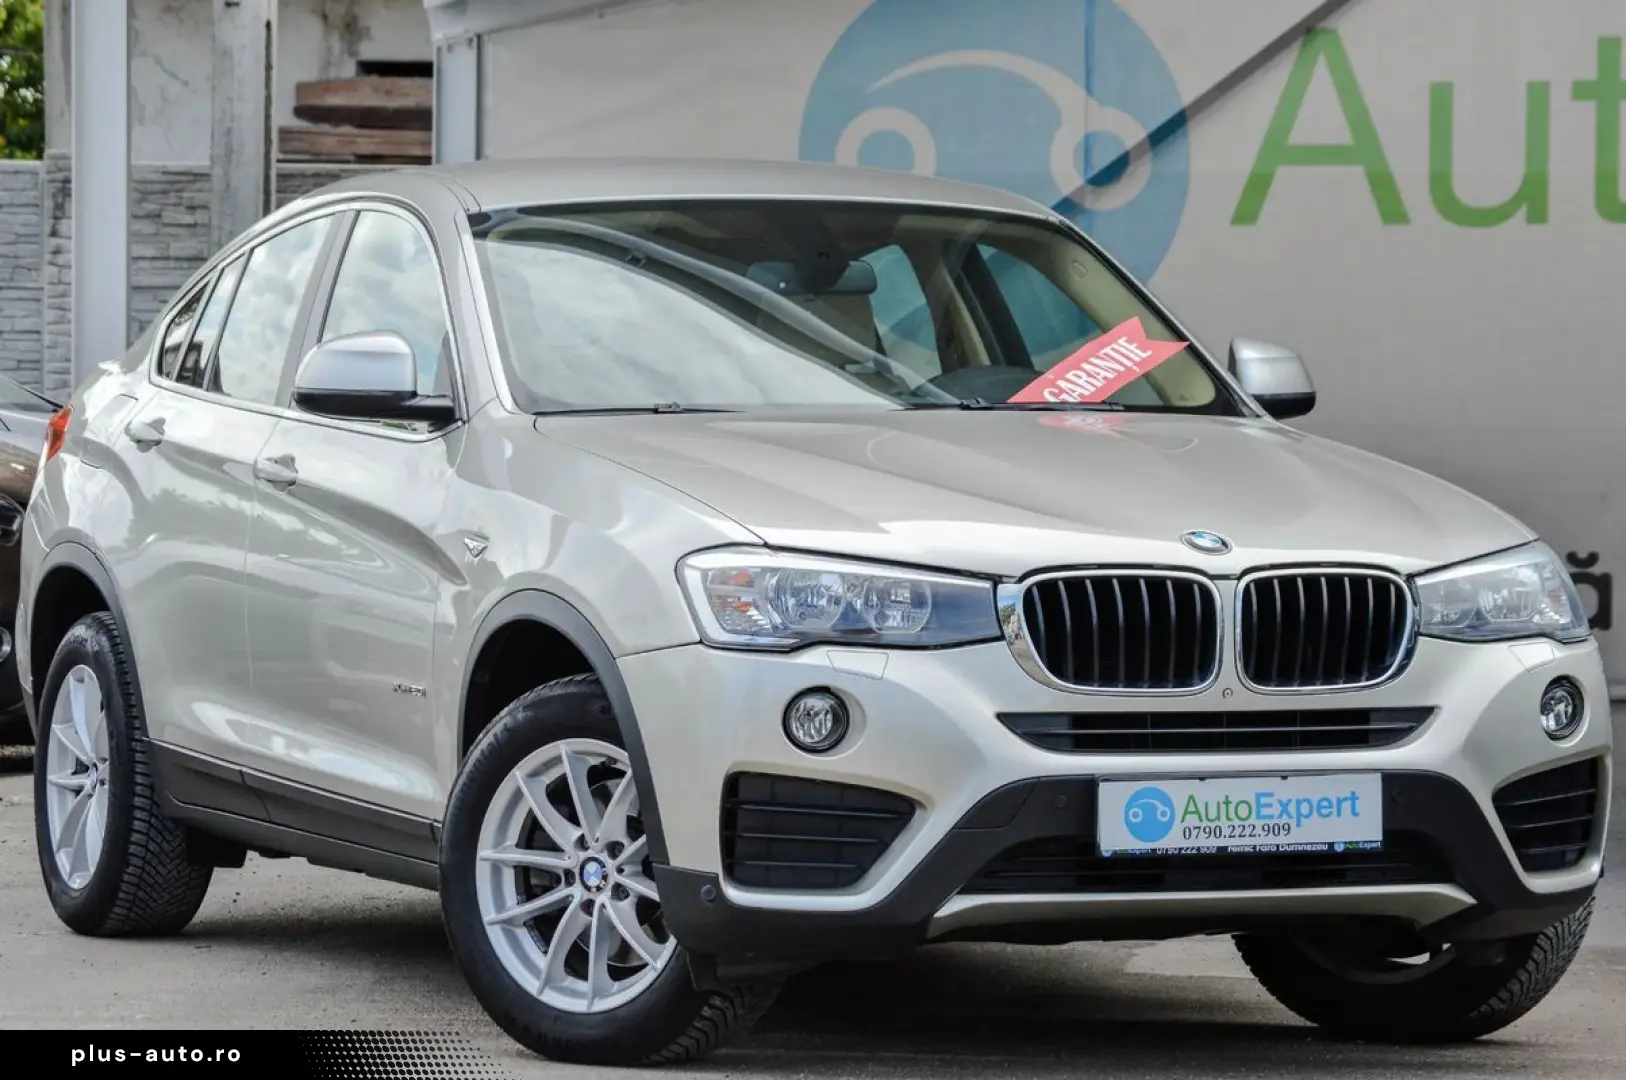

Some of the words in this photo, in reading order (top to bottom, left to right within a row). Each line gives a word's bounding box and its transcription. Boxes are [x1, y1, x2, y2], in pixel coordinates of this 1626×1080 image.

[1230, 27, 1626, 228] Aut
[1180, 790, 1361, 828] AutoExpert
[1182, 822, 1292, 841] 0790.222.909
